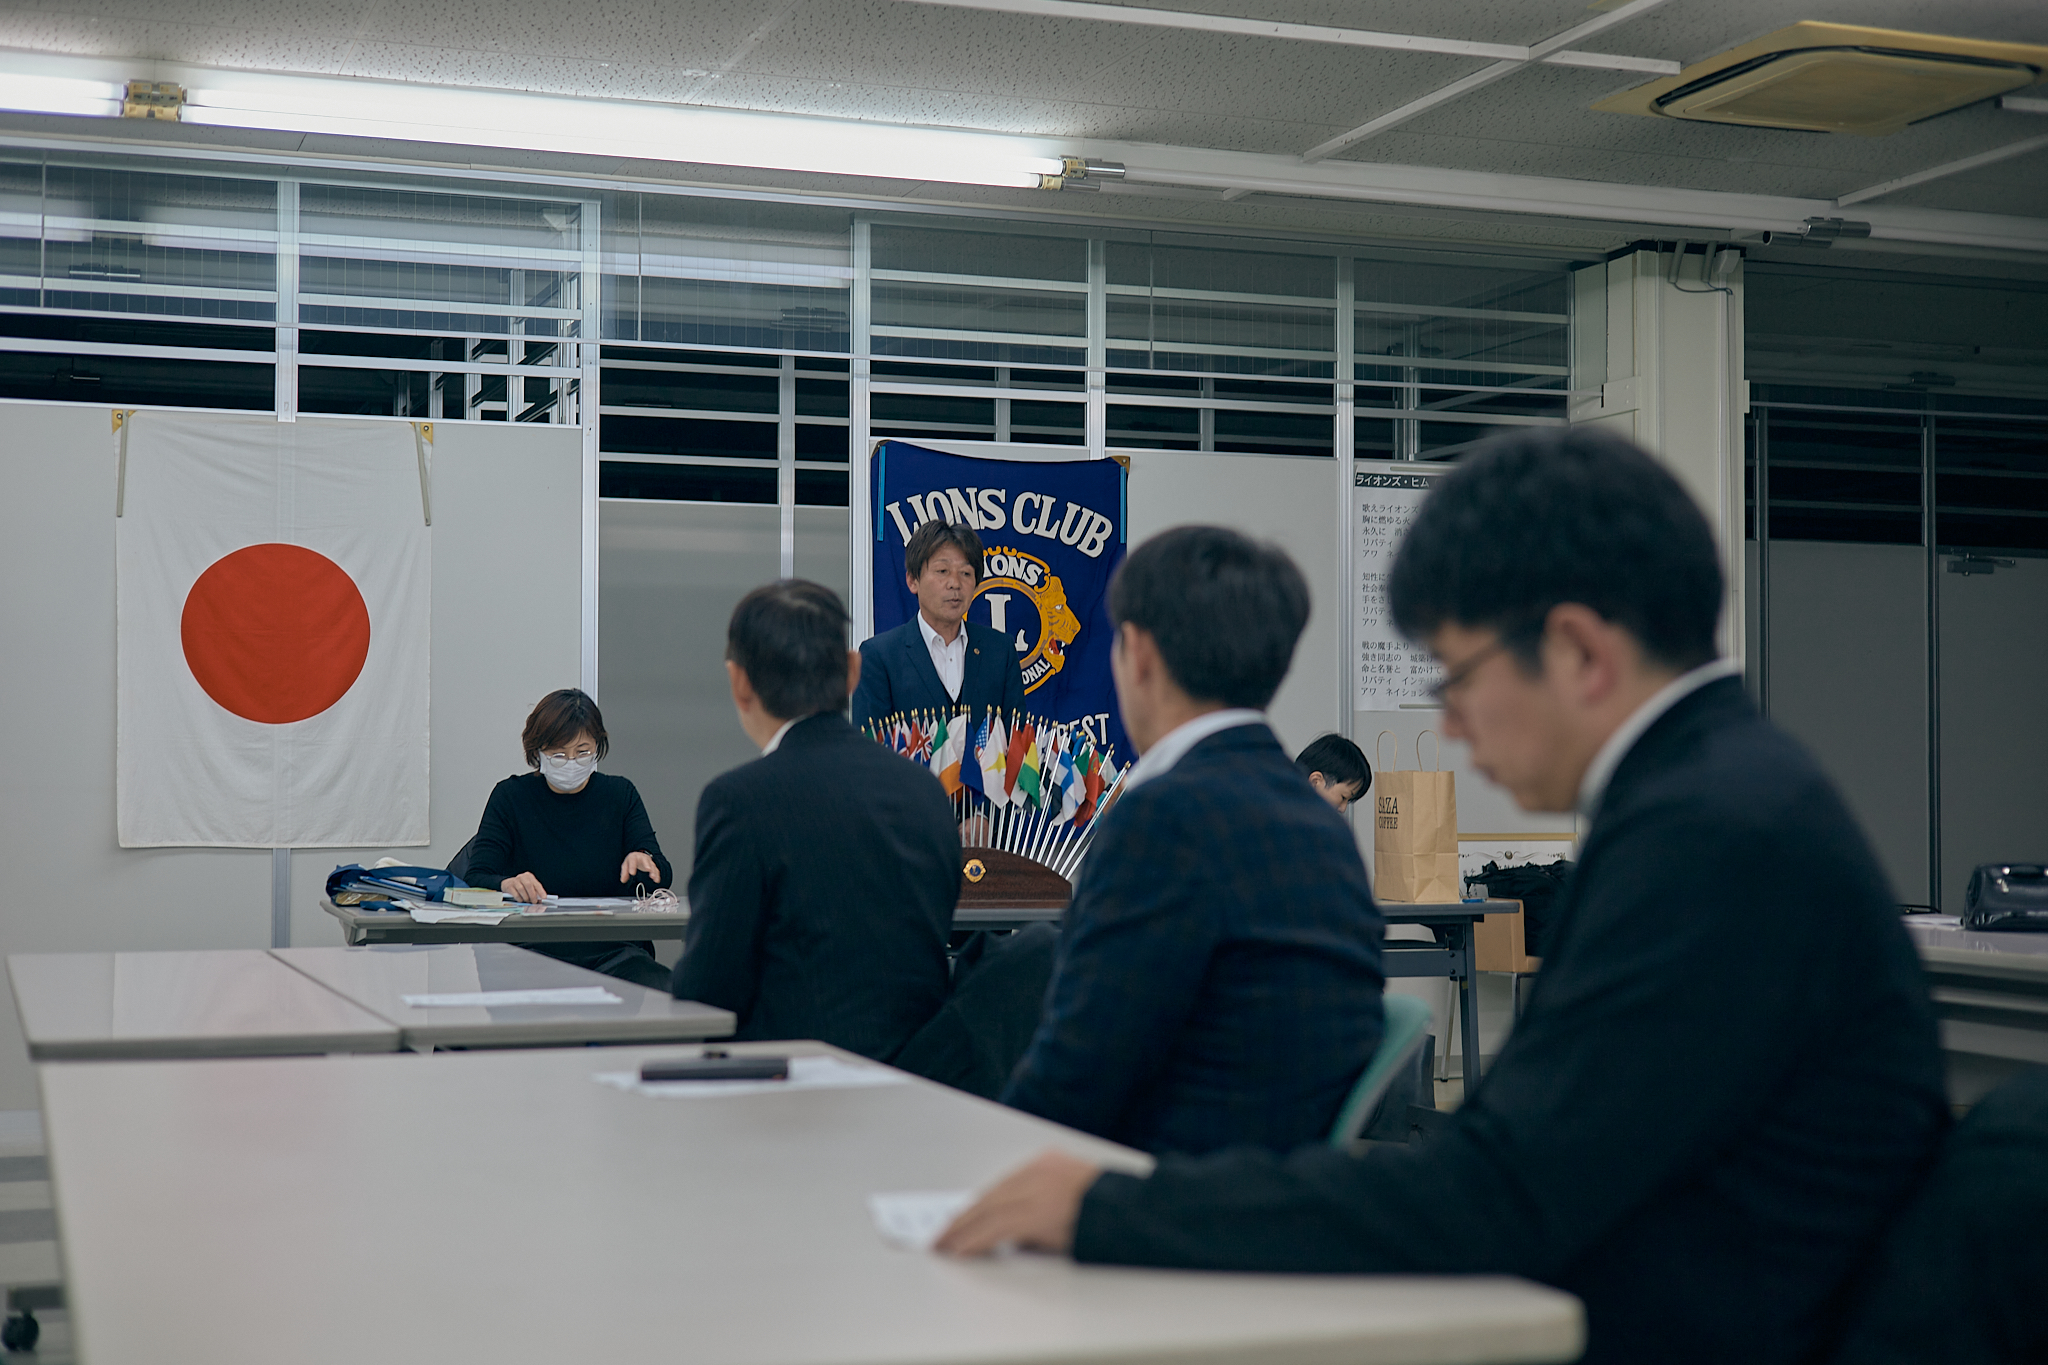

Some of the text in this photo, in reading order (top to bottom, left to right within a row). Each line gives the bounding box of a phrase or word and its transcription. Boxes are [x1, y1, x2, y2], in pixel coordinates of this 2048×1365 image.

[886, 487, 1113, 558] LIONS CLUB
[983, 554, 1043, 586] IONS
